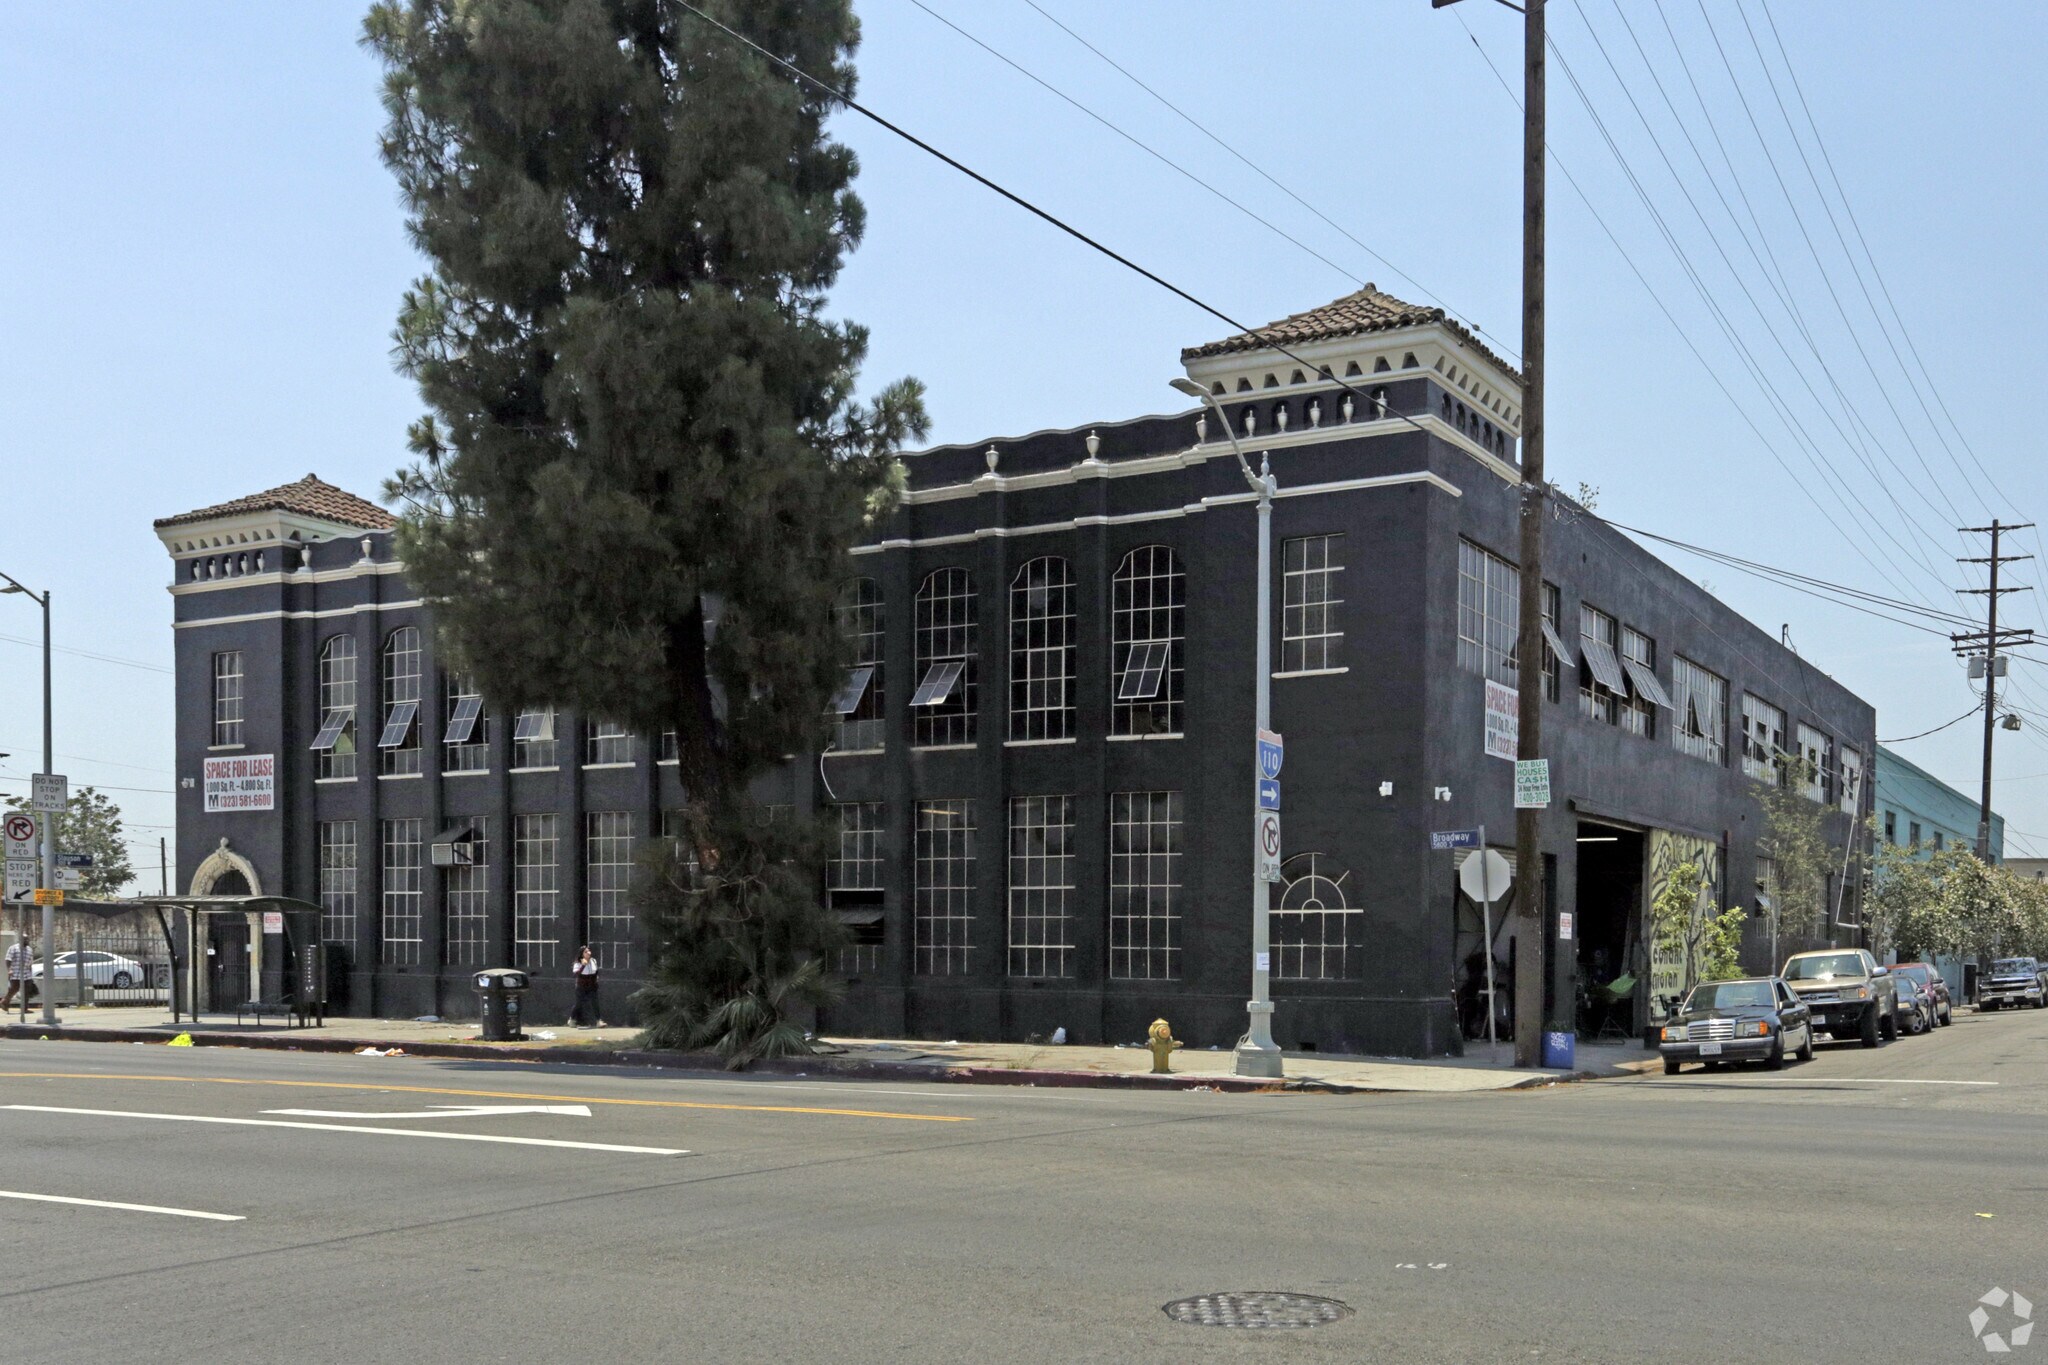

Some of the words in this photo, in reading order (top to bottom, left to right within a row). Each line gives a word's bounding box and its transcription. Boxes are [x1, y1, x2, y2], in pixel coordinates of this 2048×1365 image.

[1487, 685, 1506, 714] SPACE
[1264, 750, 1278, 770] 110
[206, 761, 230, 779] SPACE
[233, 760, 247, 778] FOR
[250, 759, 272, 777] LEASE
[1517, 767, 1547, 776] HOUSES
[1517, 776, 1547, 784] CA$H
[206, 782, 219, 793] 1,000
[241, 780, 256, 791] 4,800
[35, 802, 65, 810] TRACKS
[208, 795, 218, 807] M
[221, 796, 238, 808] (323)
[240, 794, 271, 807] 581-6600
[1433, 833, 1469, 842] Broadway
[13, 848, 29, 856] RED
